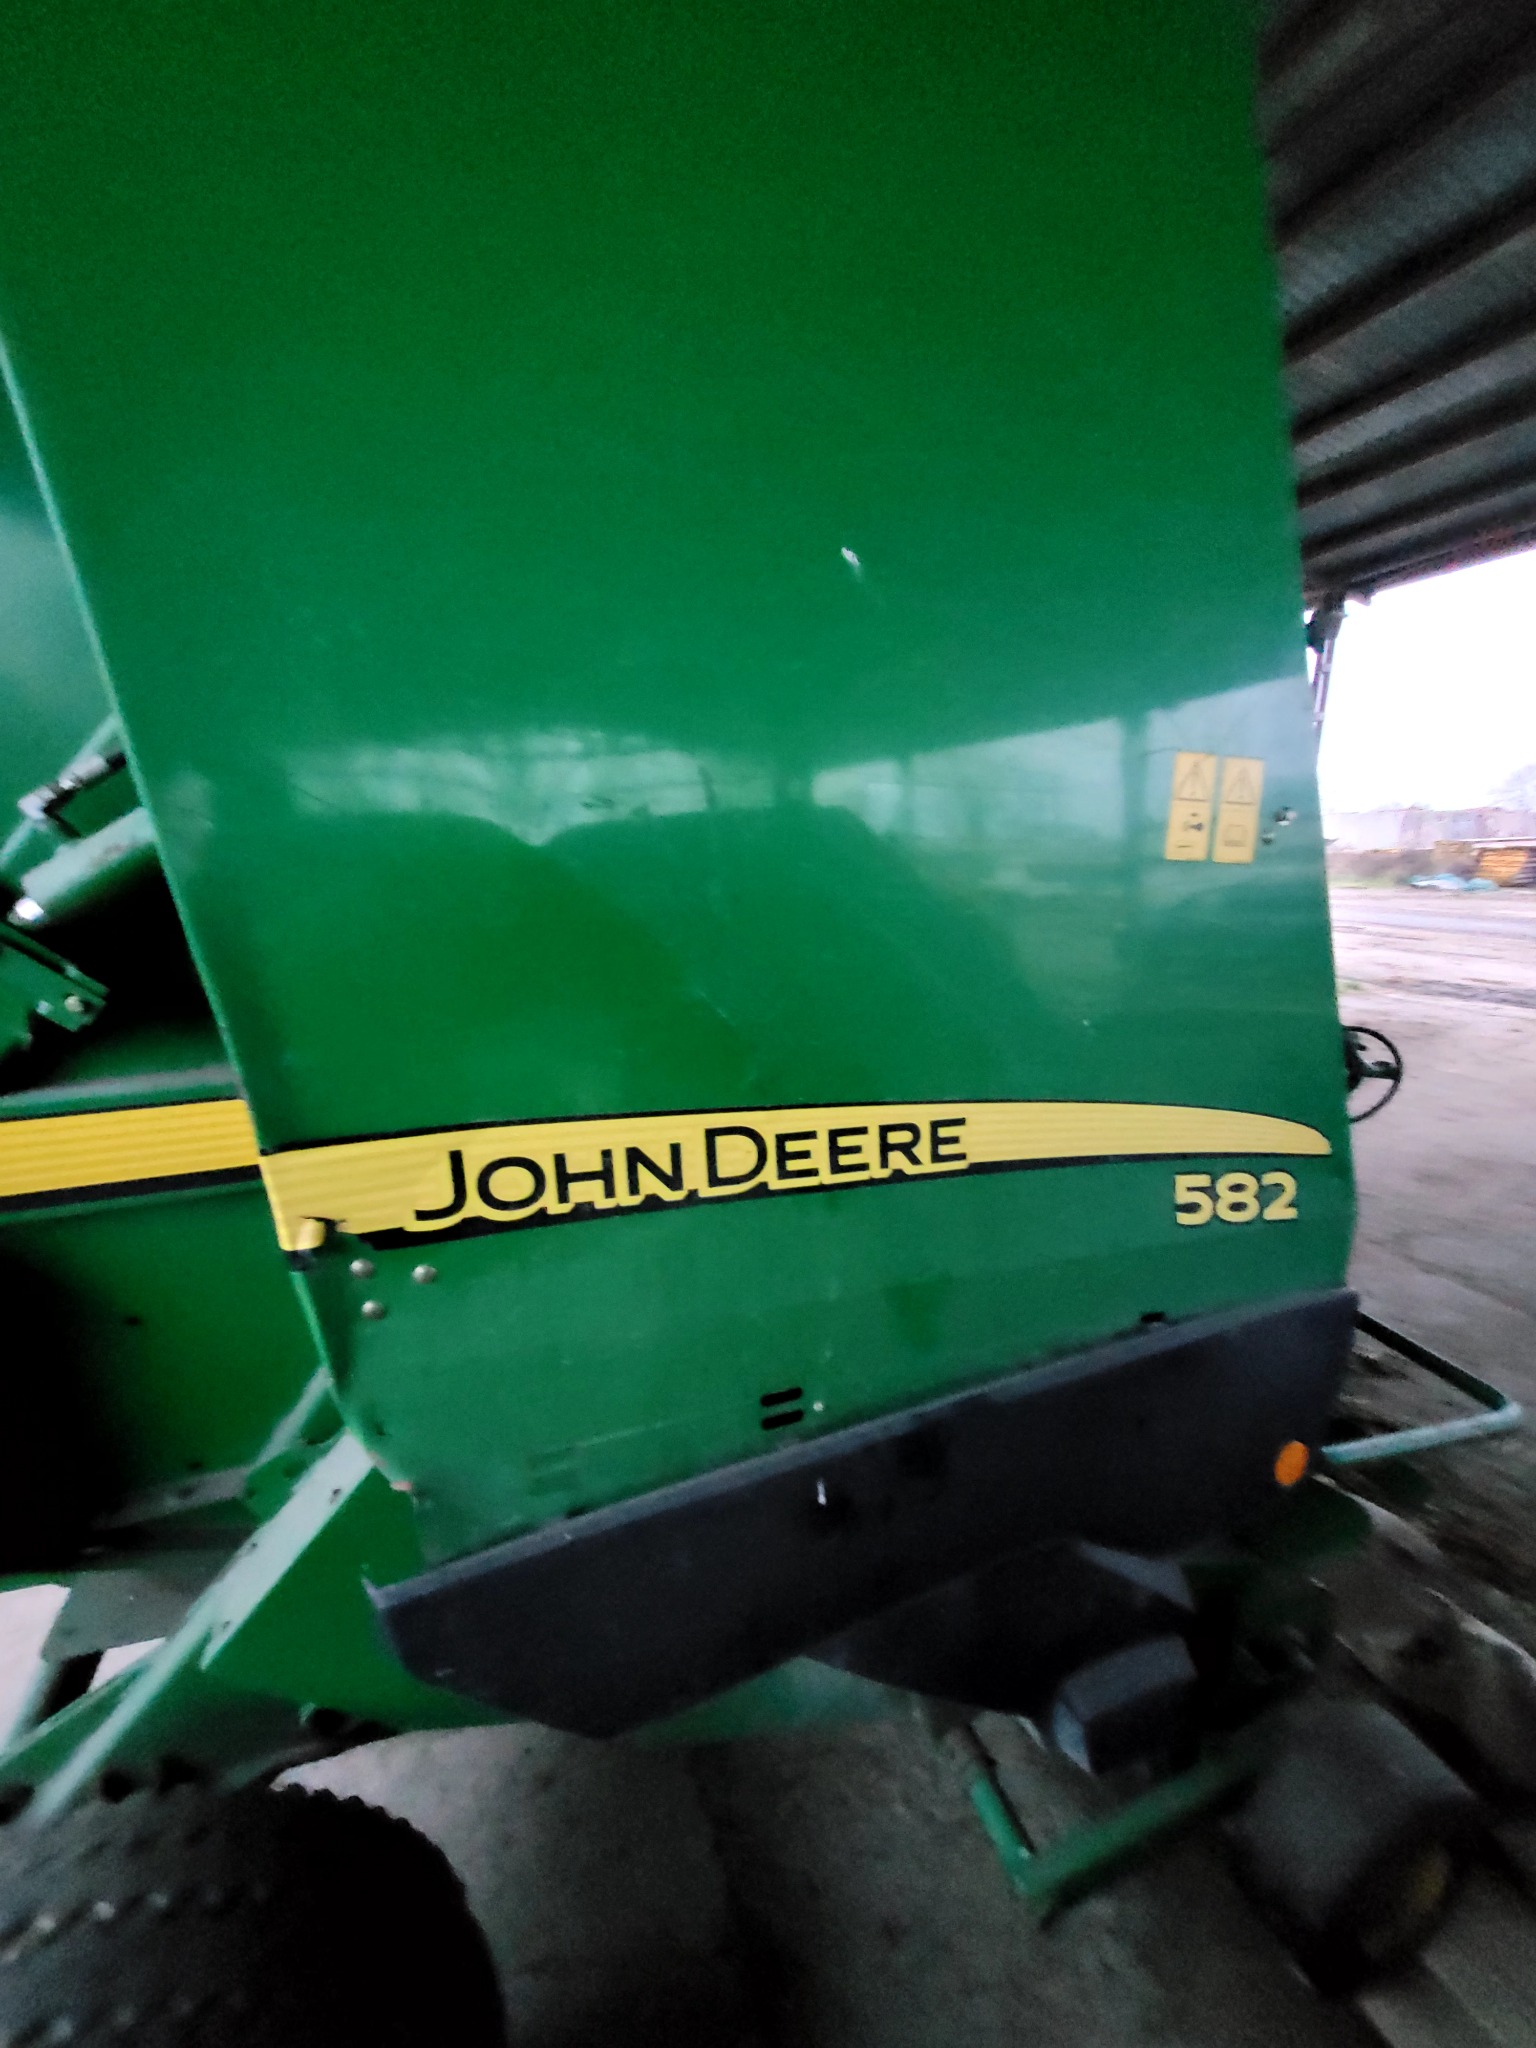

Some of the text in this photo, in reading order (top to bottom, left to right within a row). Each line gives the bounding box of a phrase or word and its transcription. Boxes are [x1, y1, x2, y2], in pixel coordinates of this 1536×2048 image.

[415, 1116, 968, 1222] JOHN DEERE
[1174, 1170, 1299, 1227] 582
